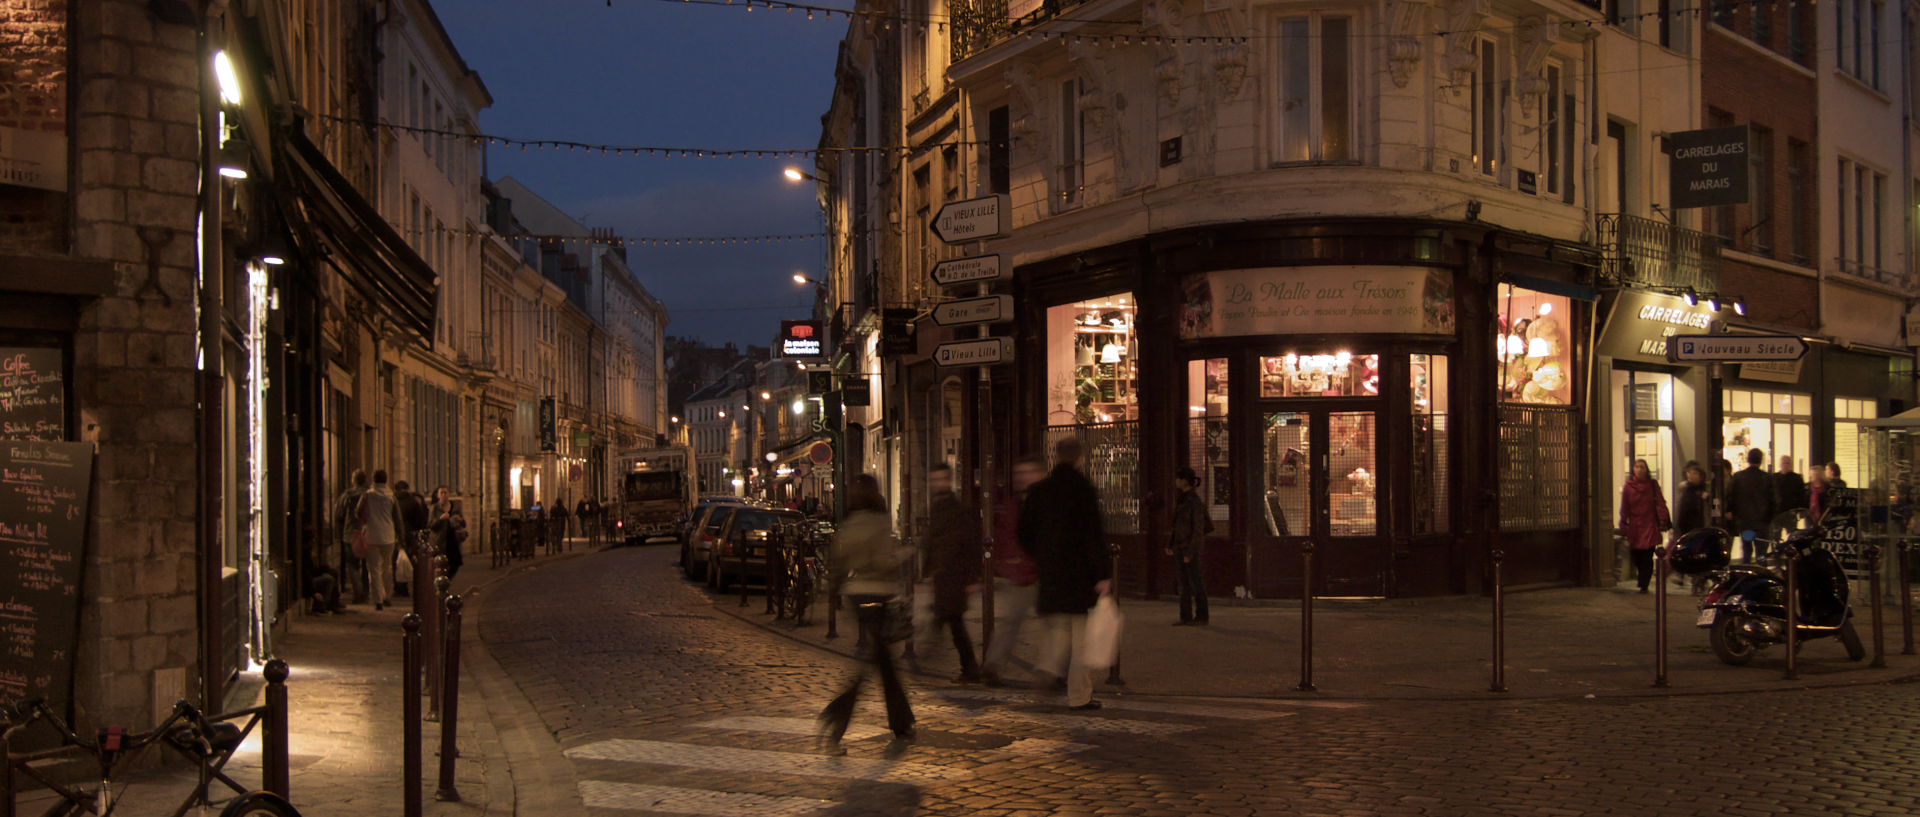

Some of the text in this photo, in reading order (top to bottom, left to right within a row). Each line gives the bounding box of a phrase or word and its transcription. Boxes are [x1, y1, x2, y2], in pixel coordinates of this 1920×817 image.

[1675, 142, 1745, 160] CARRELAGES
[1702, 162, 1718, 173] DU
[1689, 177, 1730, 192] MARAIS
[954, 204, 995, 220] VIEUX LILLE
[1260, 281, 1310, 301] Malle
[1316, 288, 1344, 299] aux
[948, 308, 968, 318] Gare
[1638, 304, 1711, 329] CARRELAGES
[1663, 327, 1676, 337] DU
[952, 350, 974, 359] Vieux
[978, 346, 996, 358] Lille
[1757, 344, 1795, 354] Siècle
